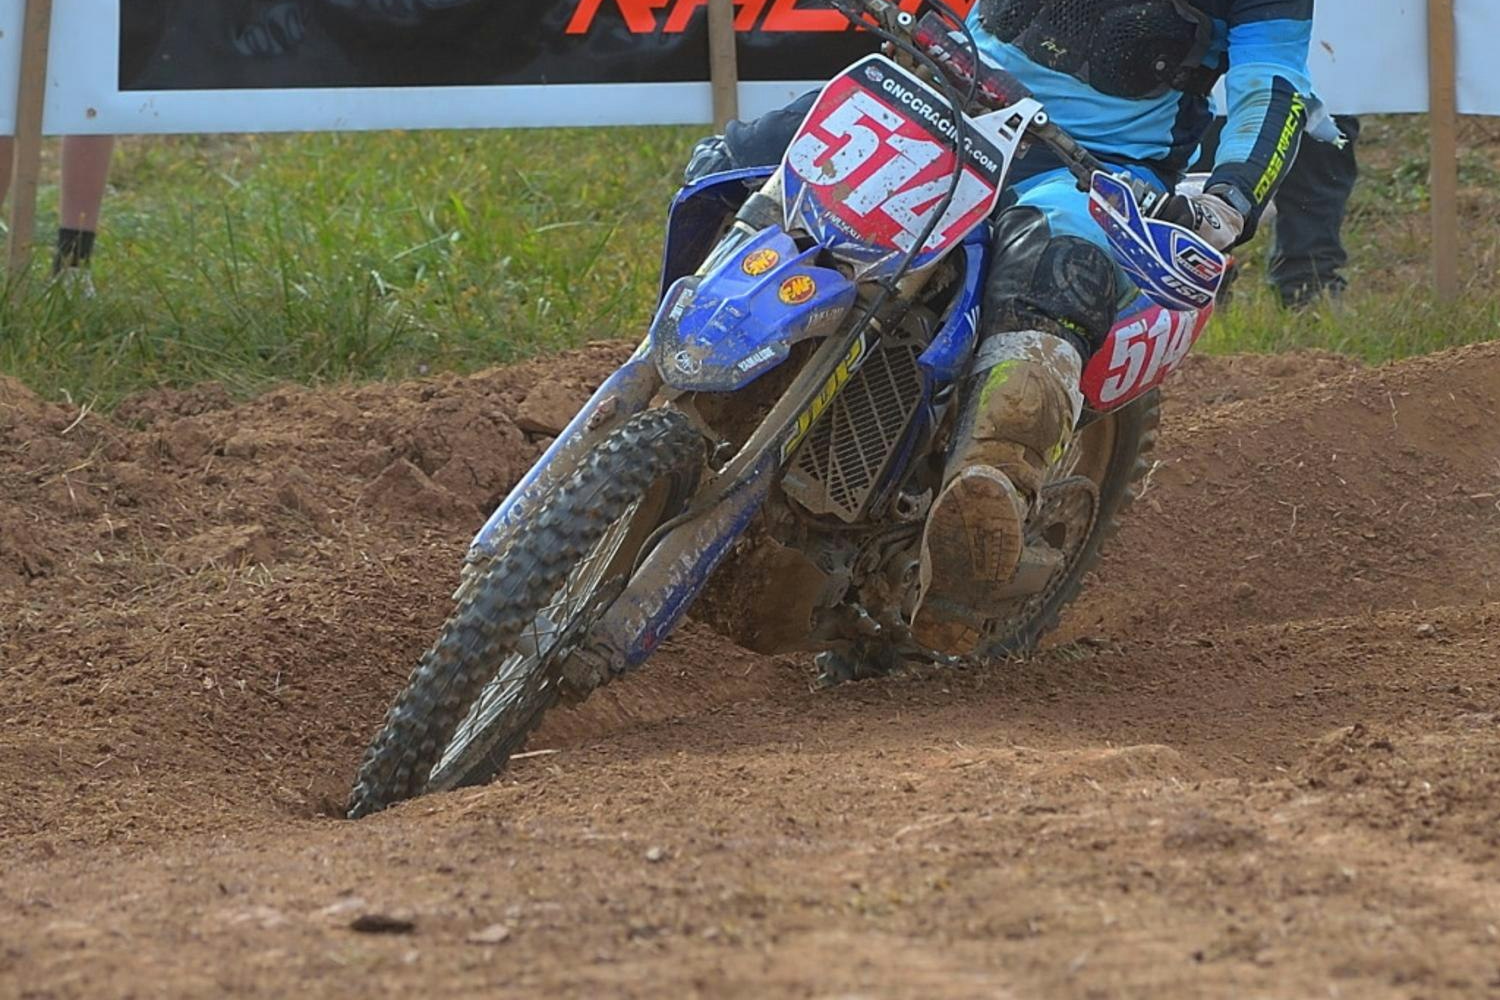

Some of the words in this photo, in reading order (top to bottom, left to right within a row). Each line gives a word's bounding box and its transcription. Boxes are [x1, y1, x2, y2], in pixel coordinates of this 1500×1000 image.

[788, 89, 993, 254] 514
[1161, 275, 1209, 303] USA
[1100, 308, 1198, 403] 514
